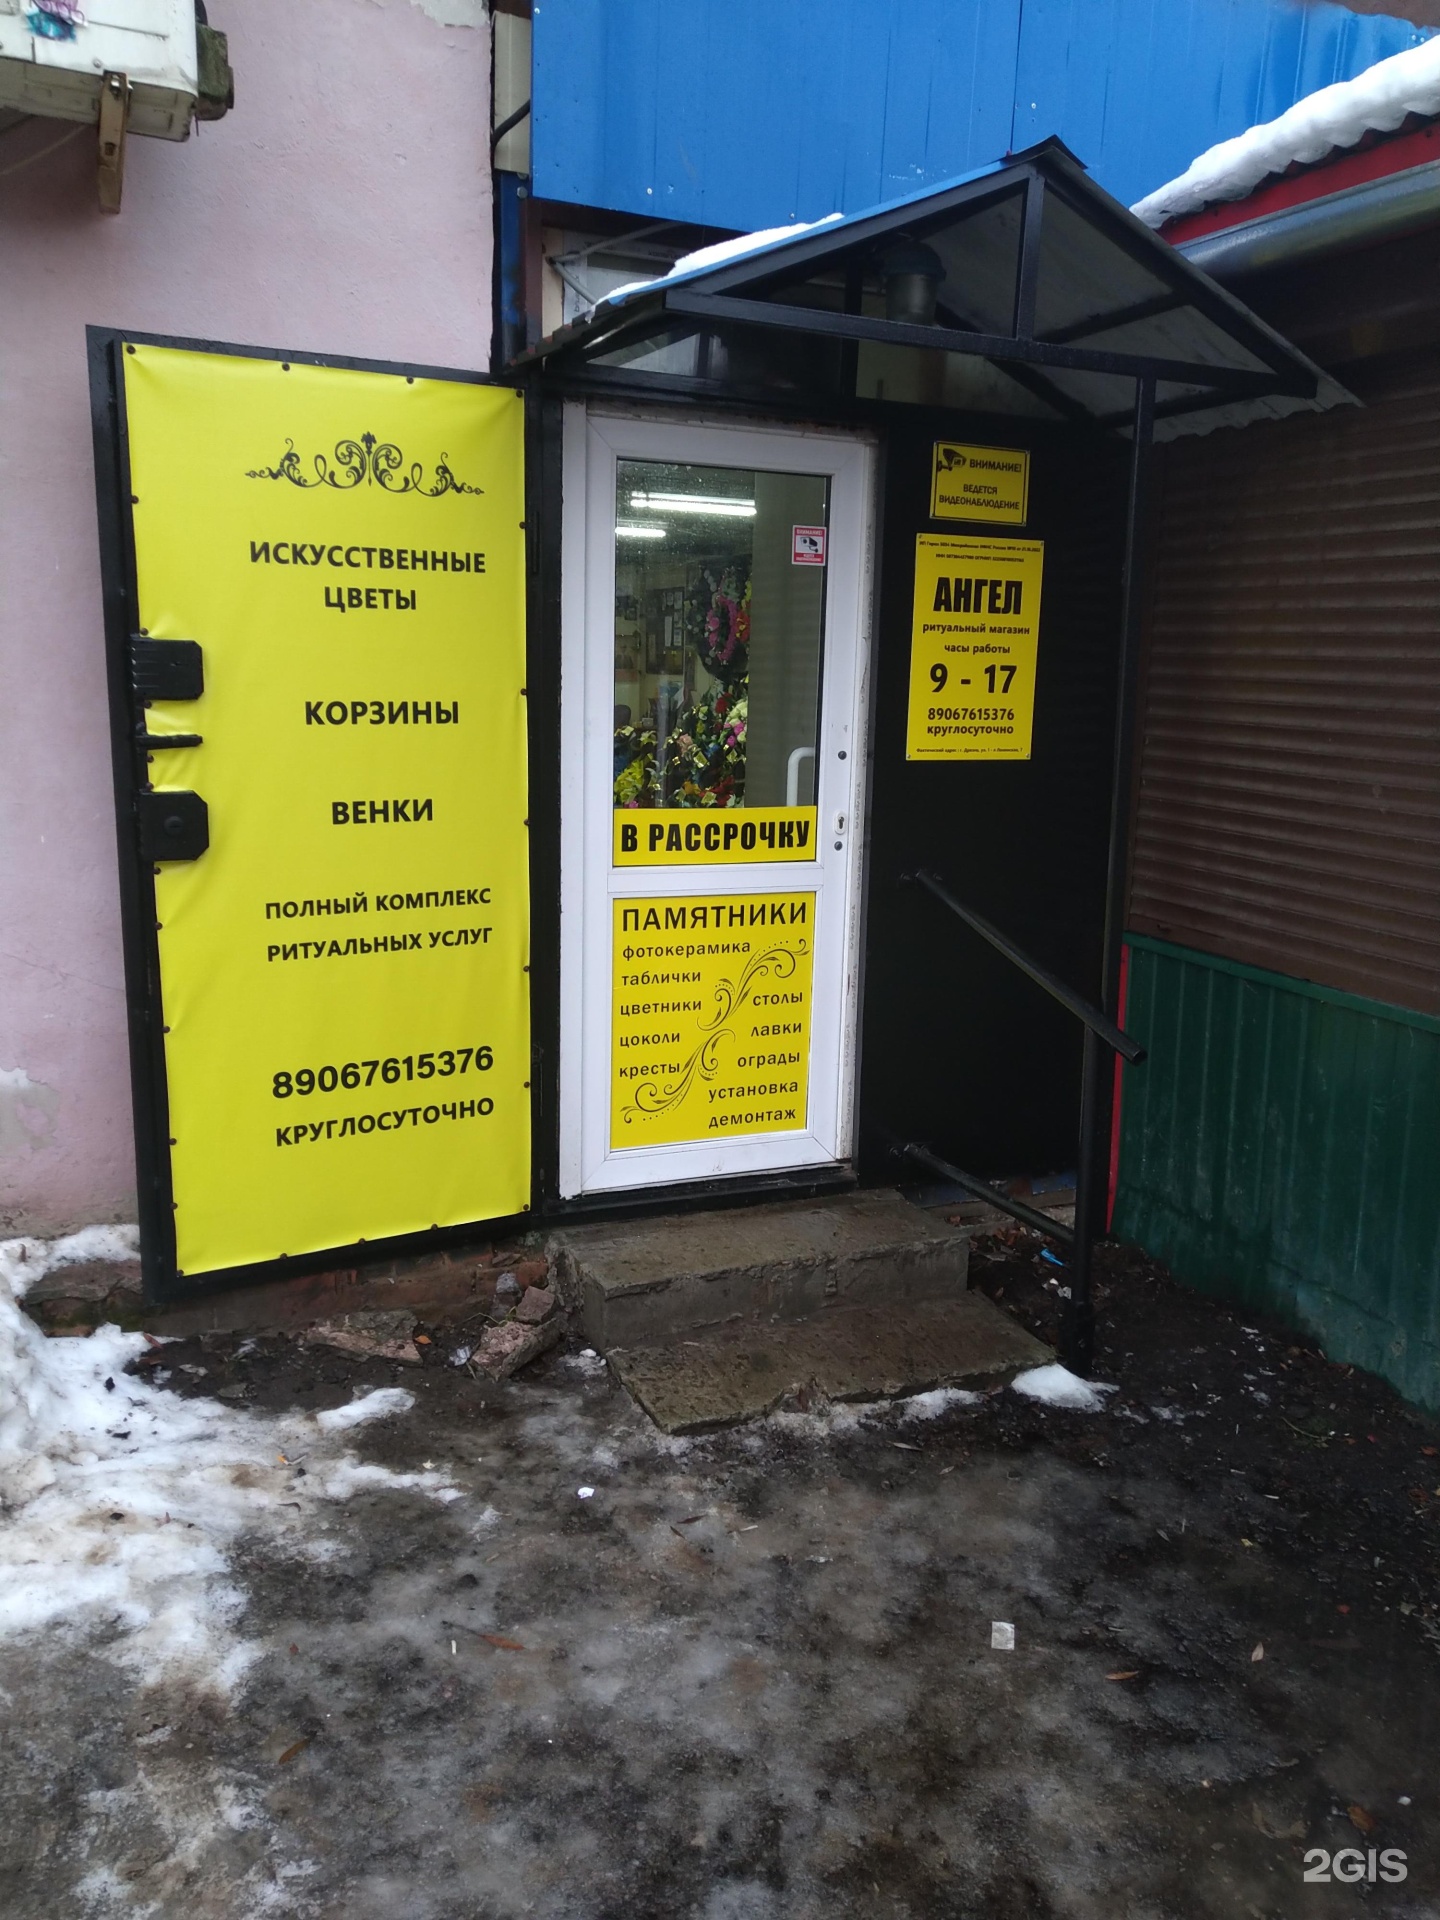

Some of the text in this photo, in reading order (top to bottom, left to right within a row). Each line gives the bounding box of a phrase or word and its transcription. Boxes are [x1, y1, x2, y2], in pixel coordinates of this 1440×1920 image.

[969, 458, 1022, 473] ВНИМАНИЕ!
[963, 483, 998, 495] ВЕДЕТСЯ
[938, 494, 1020, 510] ВИДЕОНАБЛЮДЕНИЕ
[250, 541, 486, 574] ИСКУССТВЕННЫЕ
[324, 586, 417, 614] ЦВЕТЫ
[933, 576, 1023, 615] АНГЕЛ
[922, 623, 1030, 635] ритуальный магазин
[944, 643, 1011, 655] часы работы
[929, 662, 949, 693] 9
[984, 664, 1017, 694] 17
[305, 700, 459, 726] КОРЗИНЫ
[927, 707, 1015, 721] 89067615376
[927, 725, 1014, 737] круглосуточно
[331, 798, 433, 825] ВЕНКИ
[621, 820, 810, 852] В РАССРОЧКУ
[265, 887, 491, 920] ПОЛНЫЙ КОМПЛЕКС
[622, 901, 807, 932] ПАМЯТНИКИ
[267, 927, 493, 962] РИТУАЛЬНЫХ УСЛУГ
[622, 942, 751, 962] фотокерамика
[621, 970, 701, 986] таблички
[620, 1000, 702, 1017] цветники
[752, 992, 803, 1007] столы
[750, 1022, 802, 1037] лавки
[620, 1032, 680, 1048] цоколи
[737, 1052, 800, 1069] ограды
[272, 1045, 495, 1099] 89067615376
[619, 1062, 680, 1080] кресты
[708, 1080, 799, 1103] установка
[275, 1097, 495, 1148] КРУГЛОСУТОЧНО
[708, 1108, 796, 1130] демонтаж
